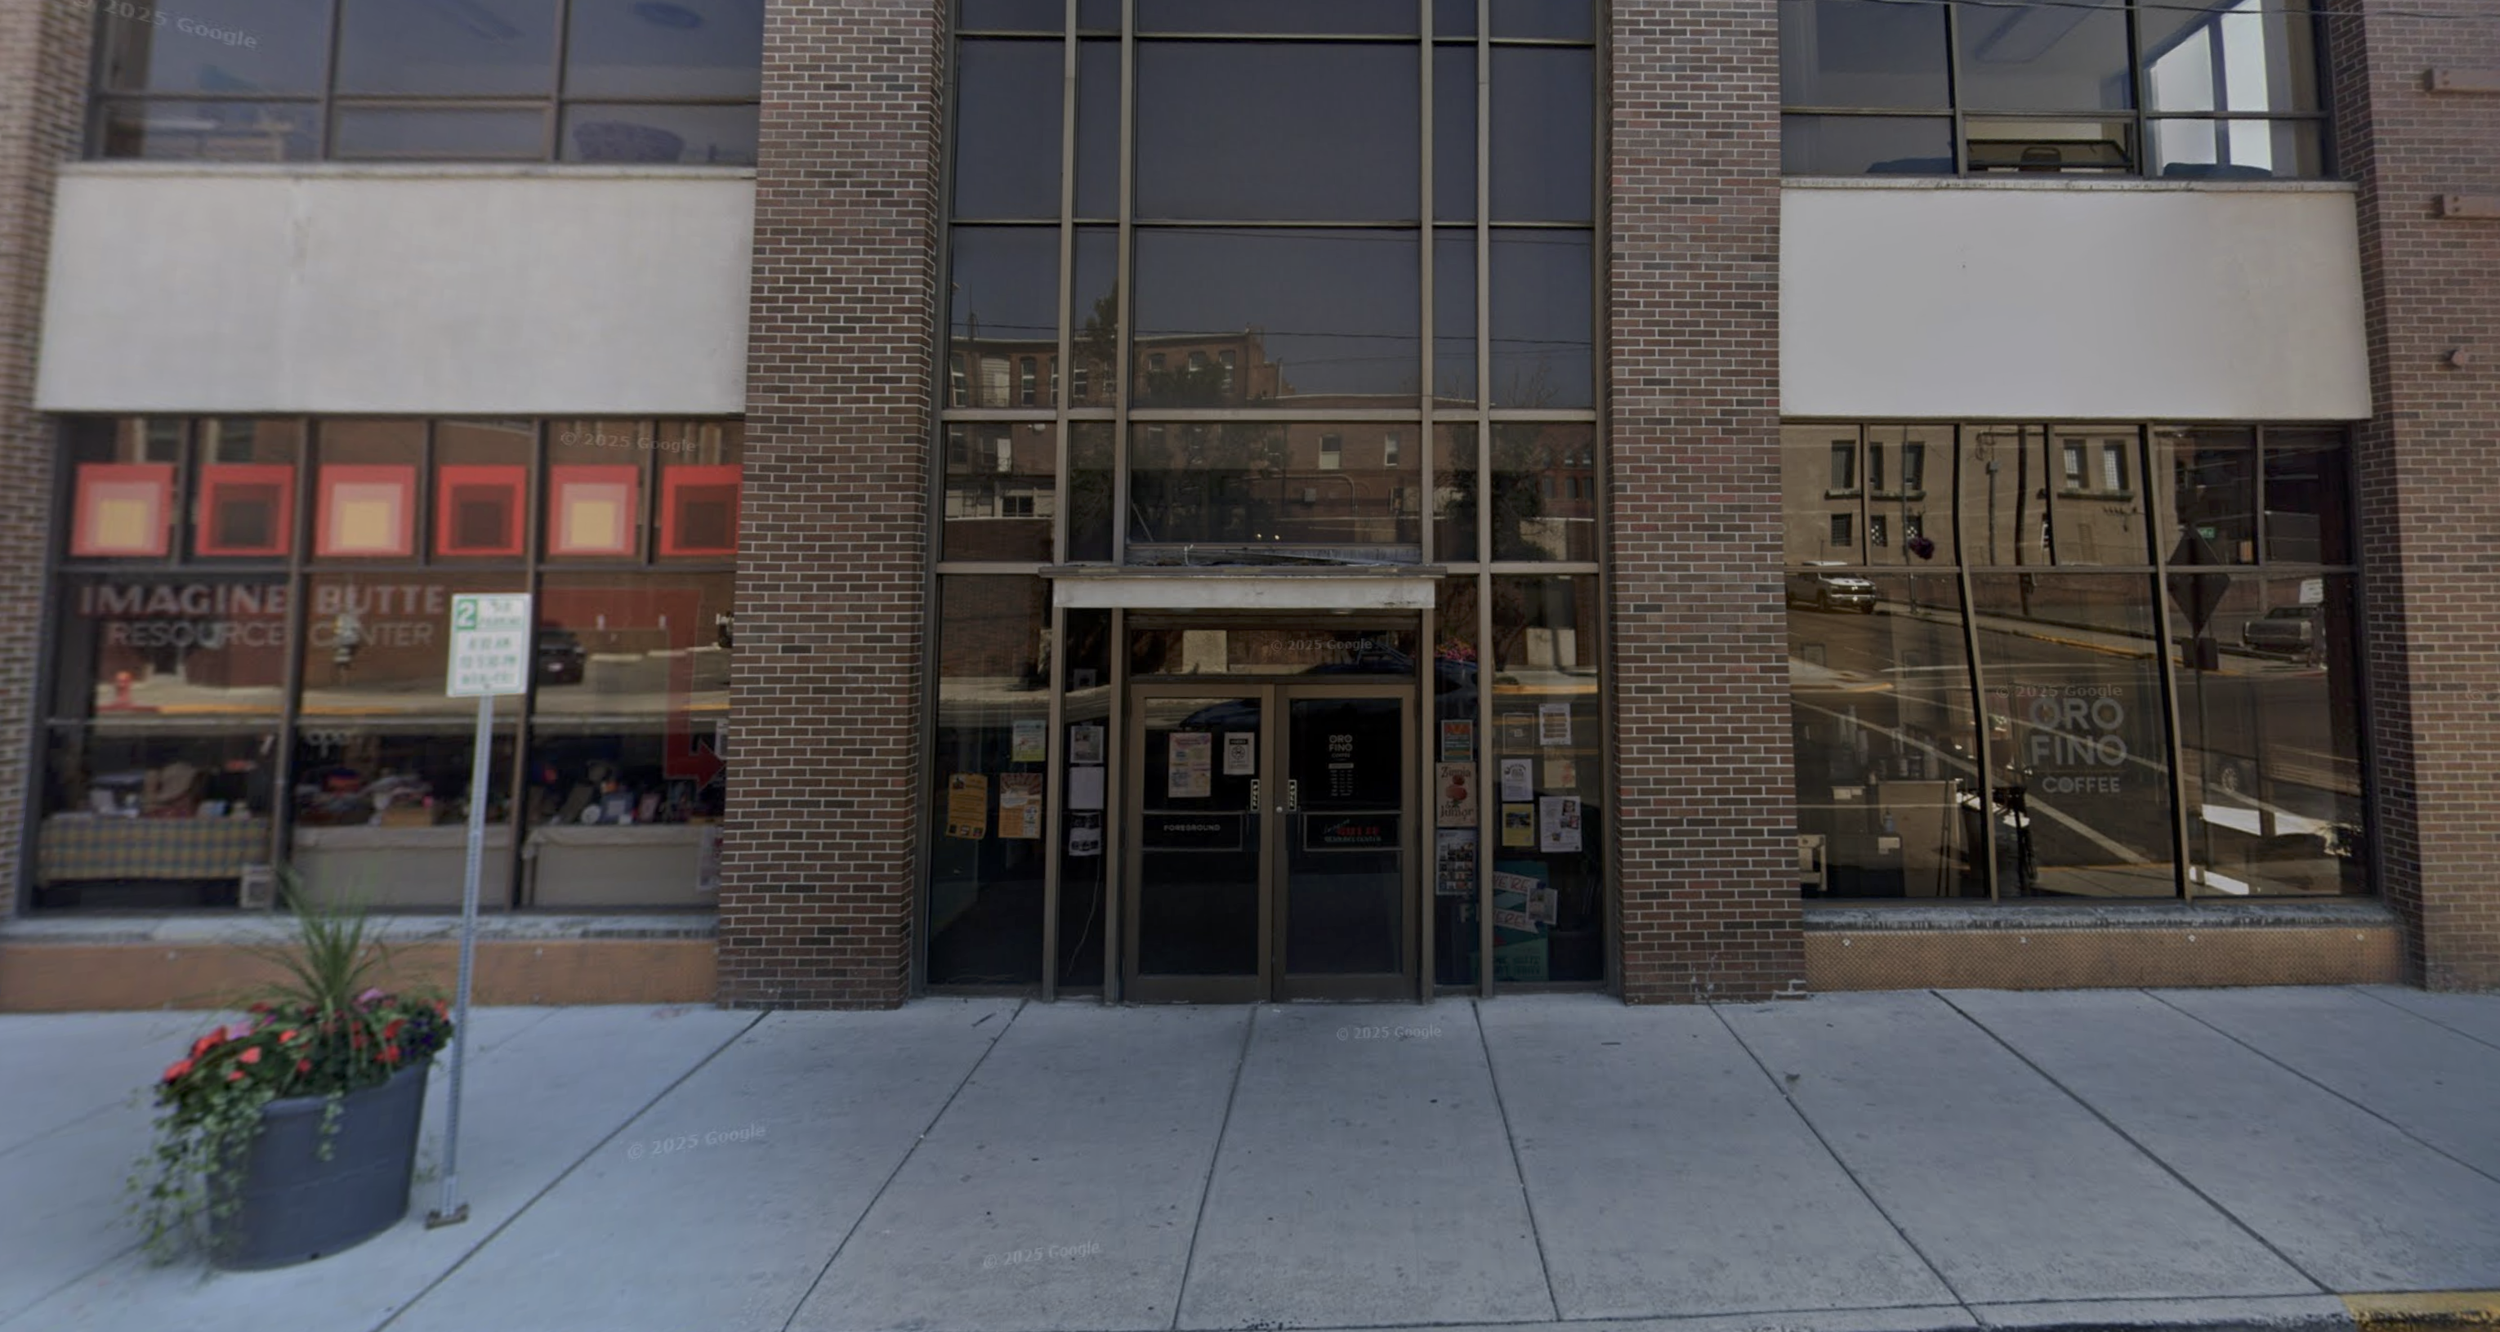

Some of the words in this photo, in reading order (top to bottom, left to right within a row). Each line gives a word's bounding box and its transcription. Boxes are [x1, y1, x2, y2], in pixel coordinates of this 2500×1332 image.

[79, 583, 286, 615] IMAGINE
[315, 583, 446, 615] BUTTE
[457, 602, 475, 627] 2
[105, 620, 285, 648] RESOURCE
[309, 620, 435, 648] CNTER
[2029, 697, 2125, 731] ORO
[1329, 734, 1353, 743] ORO
[1329, 743, 1353, 752] FINO
[2030, 734, 2128, 767] FINO
[1440, 764, 1472, 780] Zinnia
[2042, 775, 2121, 794] COFFEE
[1163, 824, 1221, 832] FOREGROUND
